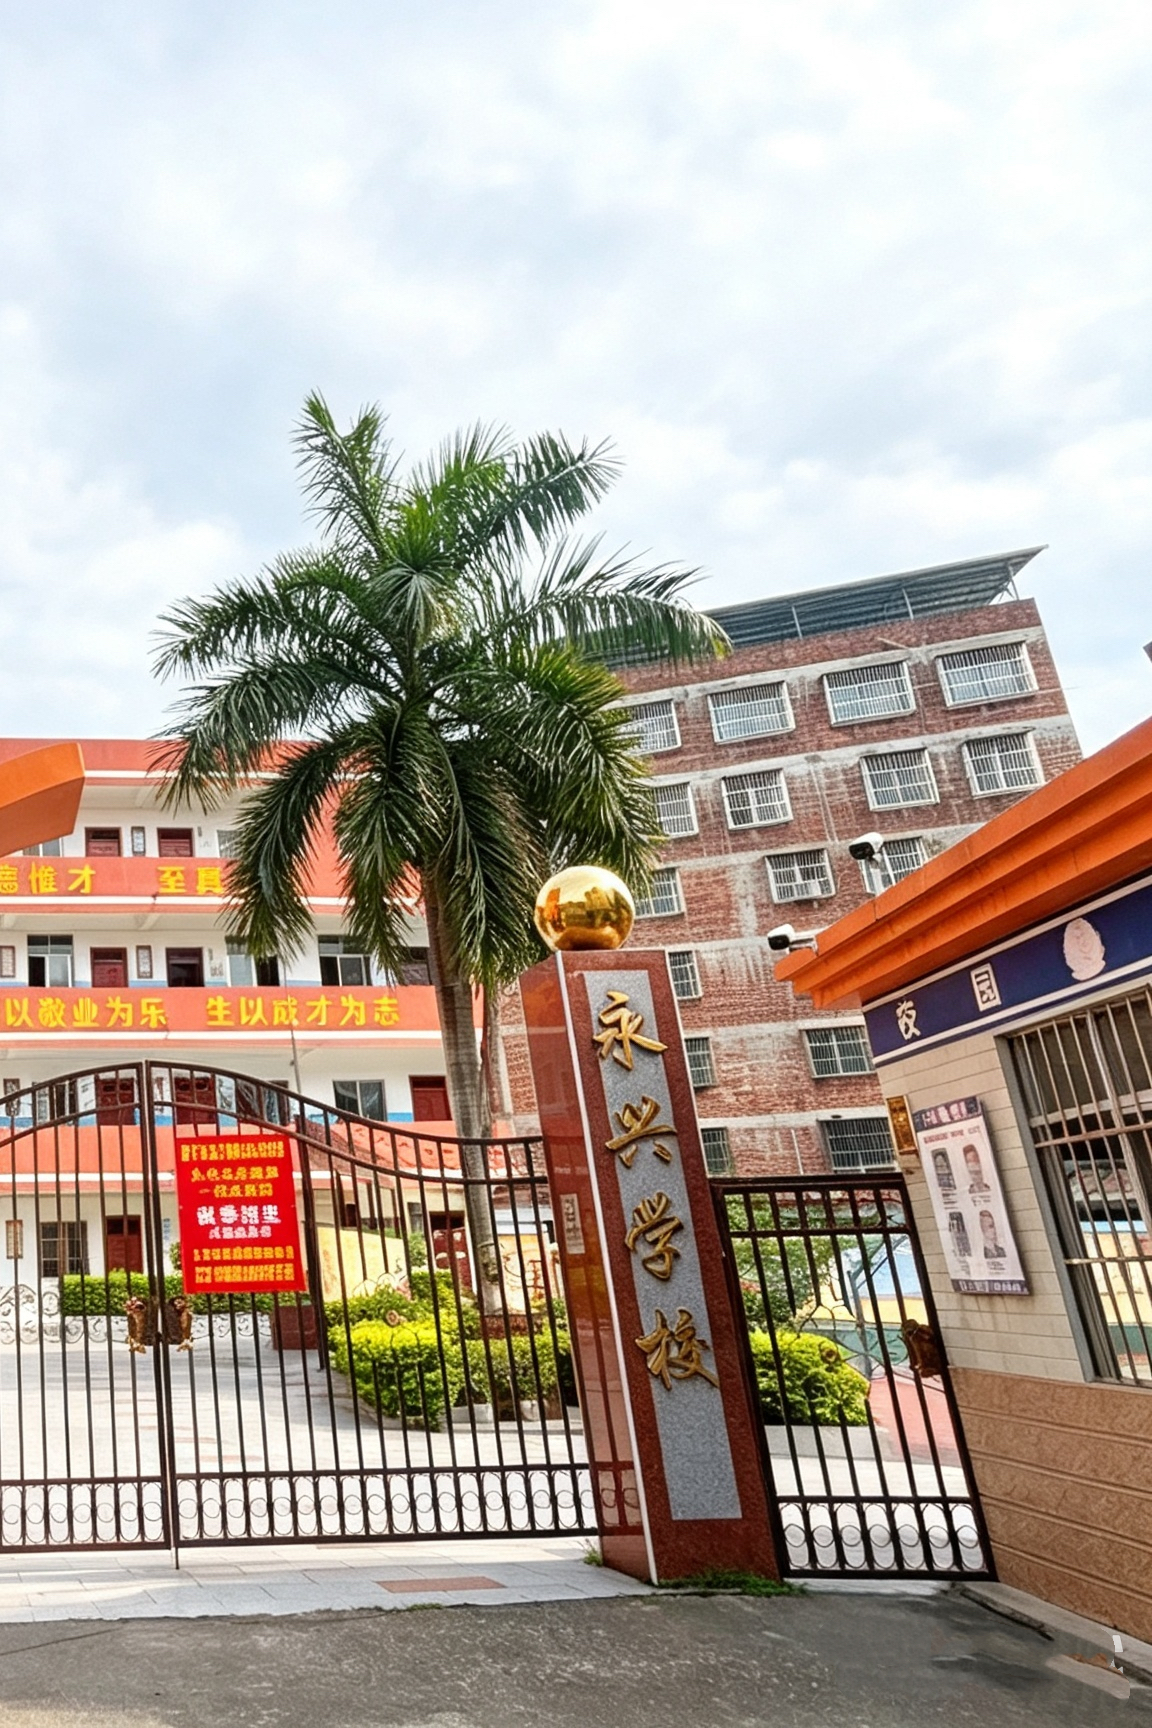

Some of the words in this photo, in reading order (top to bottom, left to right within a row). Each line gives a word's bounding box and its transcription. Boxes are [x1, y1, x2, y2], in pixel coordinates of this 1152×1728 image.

[206, 995, 400, 1028] 生以成才为志
[592, 988, 721, 1391] 永兴学校
